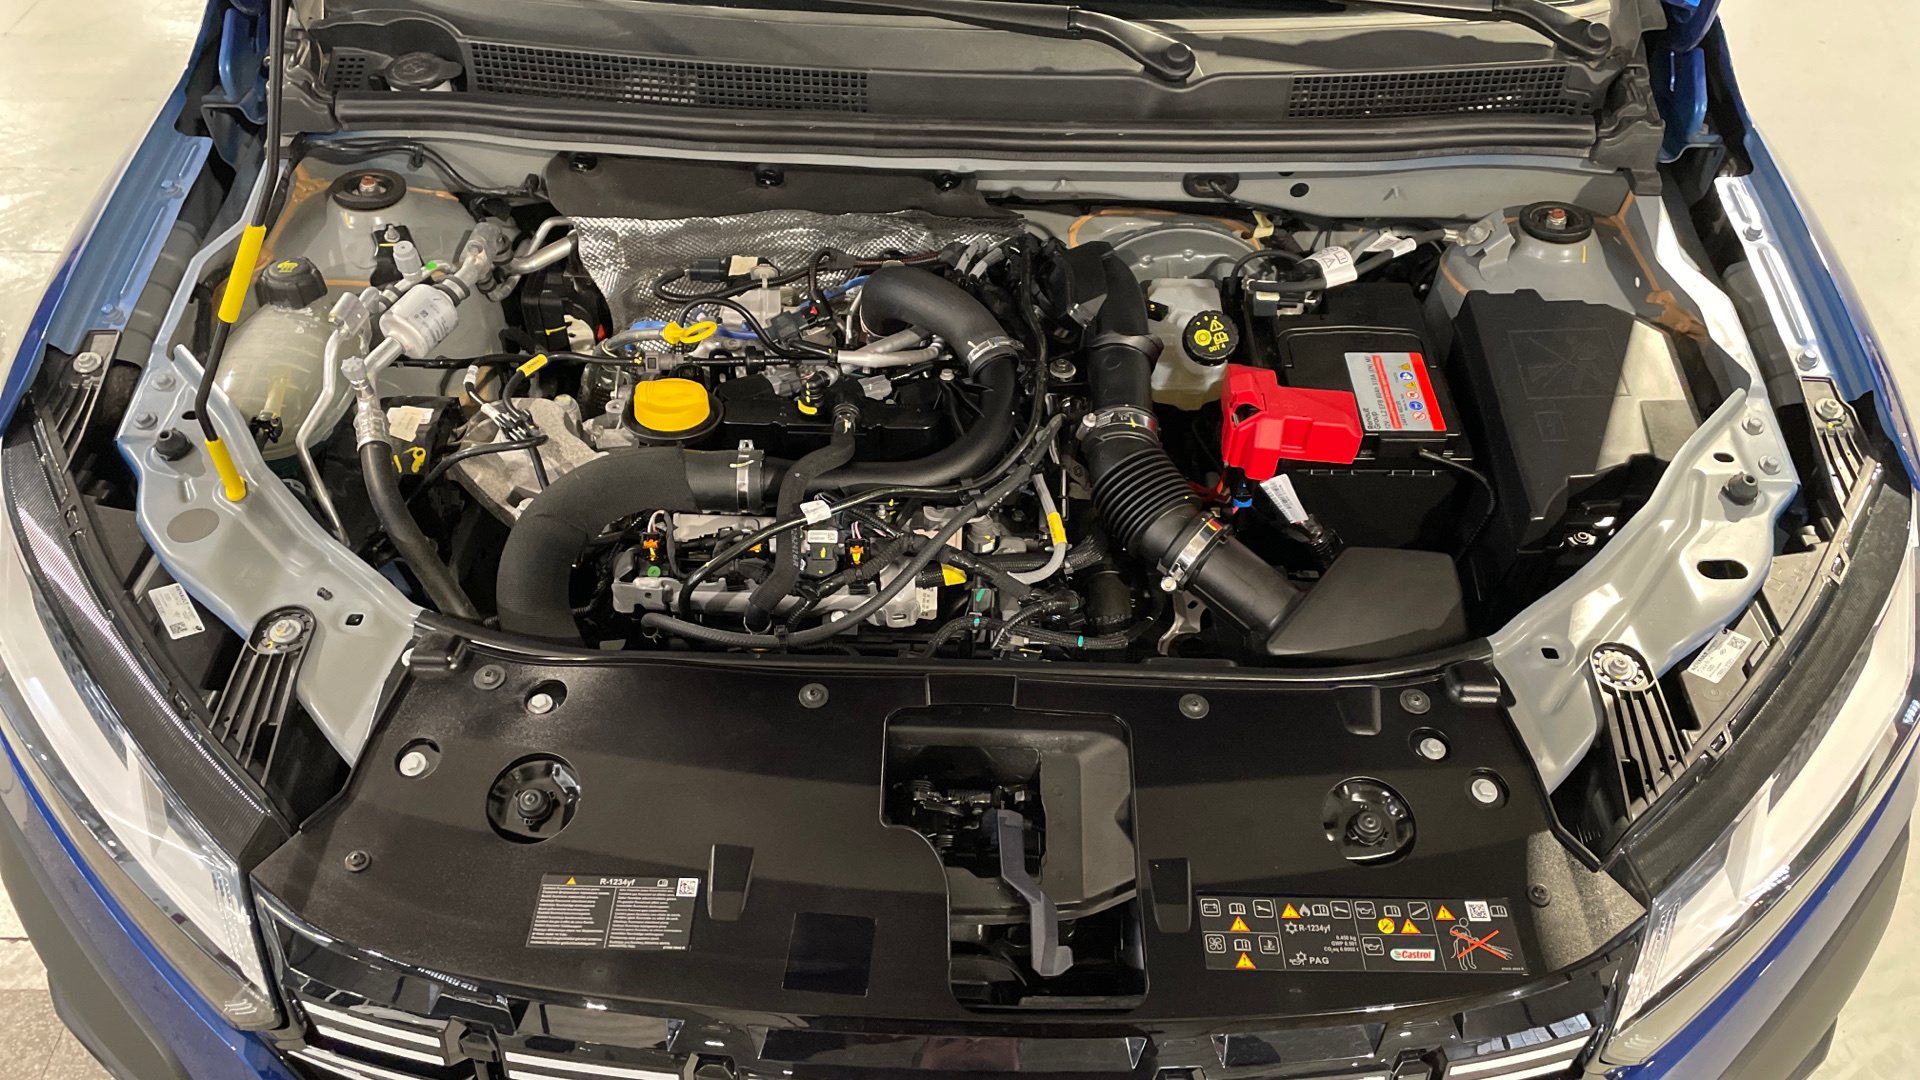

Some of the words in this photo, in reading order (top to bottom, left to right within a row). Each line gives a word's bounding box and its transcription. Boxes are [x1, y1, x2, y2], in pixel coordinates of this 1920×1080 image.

[1209, 344, 1220, 352] DOT
[1377, 399, 1385, 409] EFB
[1363, 407, 1374, 429] Renault
[1371, 411, 1382, 429] Group
[175, 585, 189, 605] RENAULT
[600, 878, 636, 887] R-1234yf
[1299, 924, 1331, 934] R-1234yf
[1402, 950, 1431, 959] Castrol
[1309, 956, 1330, 965] PAG
